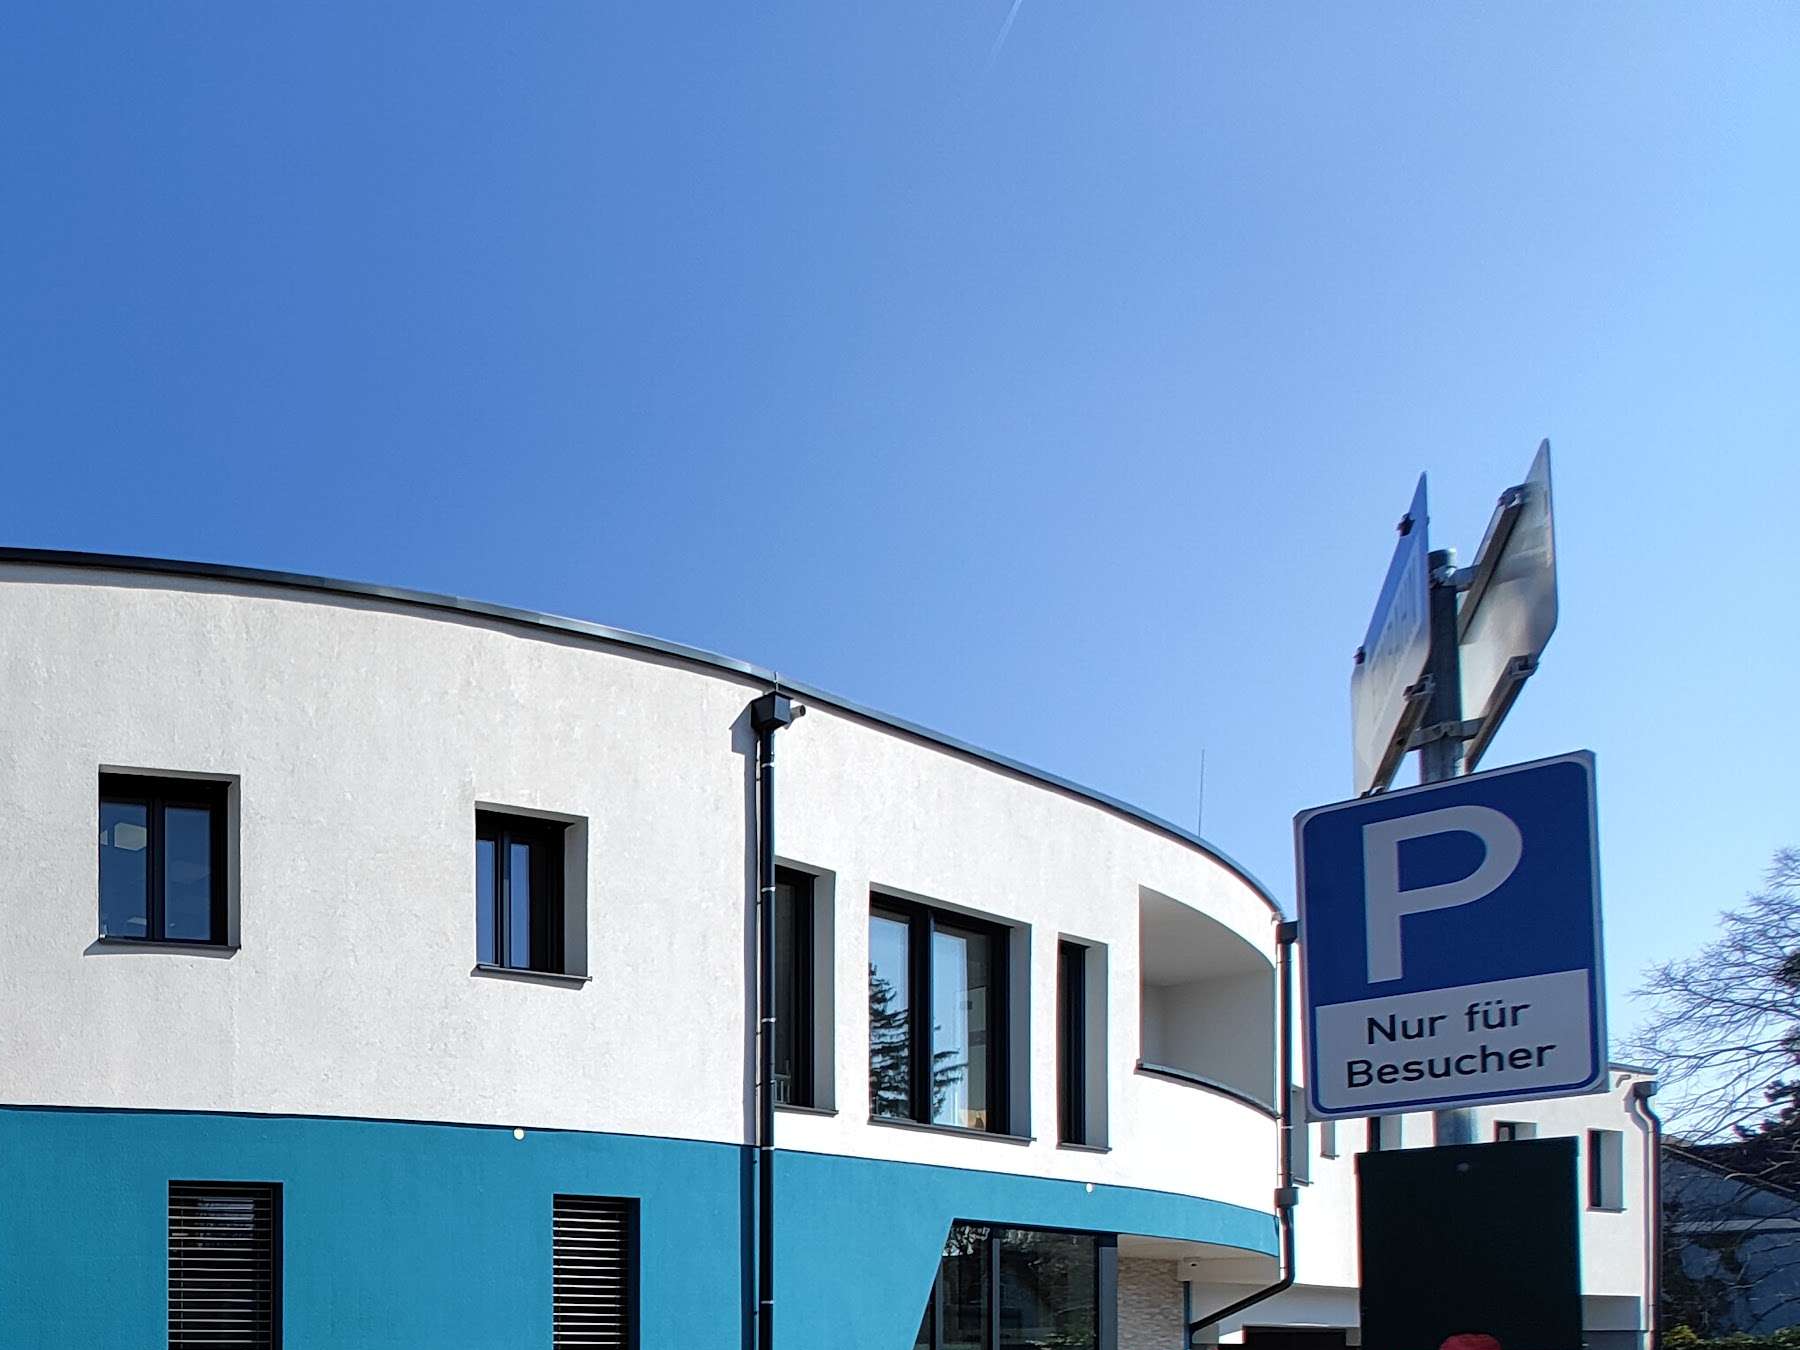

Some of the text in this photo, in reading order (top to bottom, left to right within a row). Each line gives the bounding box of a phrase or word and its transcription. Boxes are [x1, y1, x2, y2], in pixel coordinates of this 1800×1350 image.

[1362, 804, 1524, 985] P
[1366, 999, 1531, 1045] Nur für
[1346, 1044, 1556, 1088] Besucher
